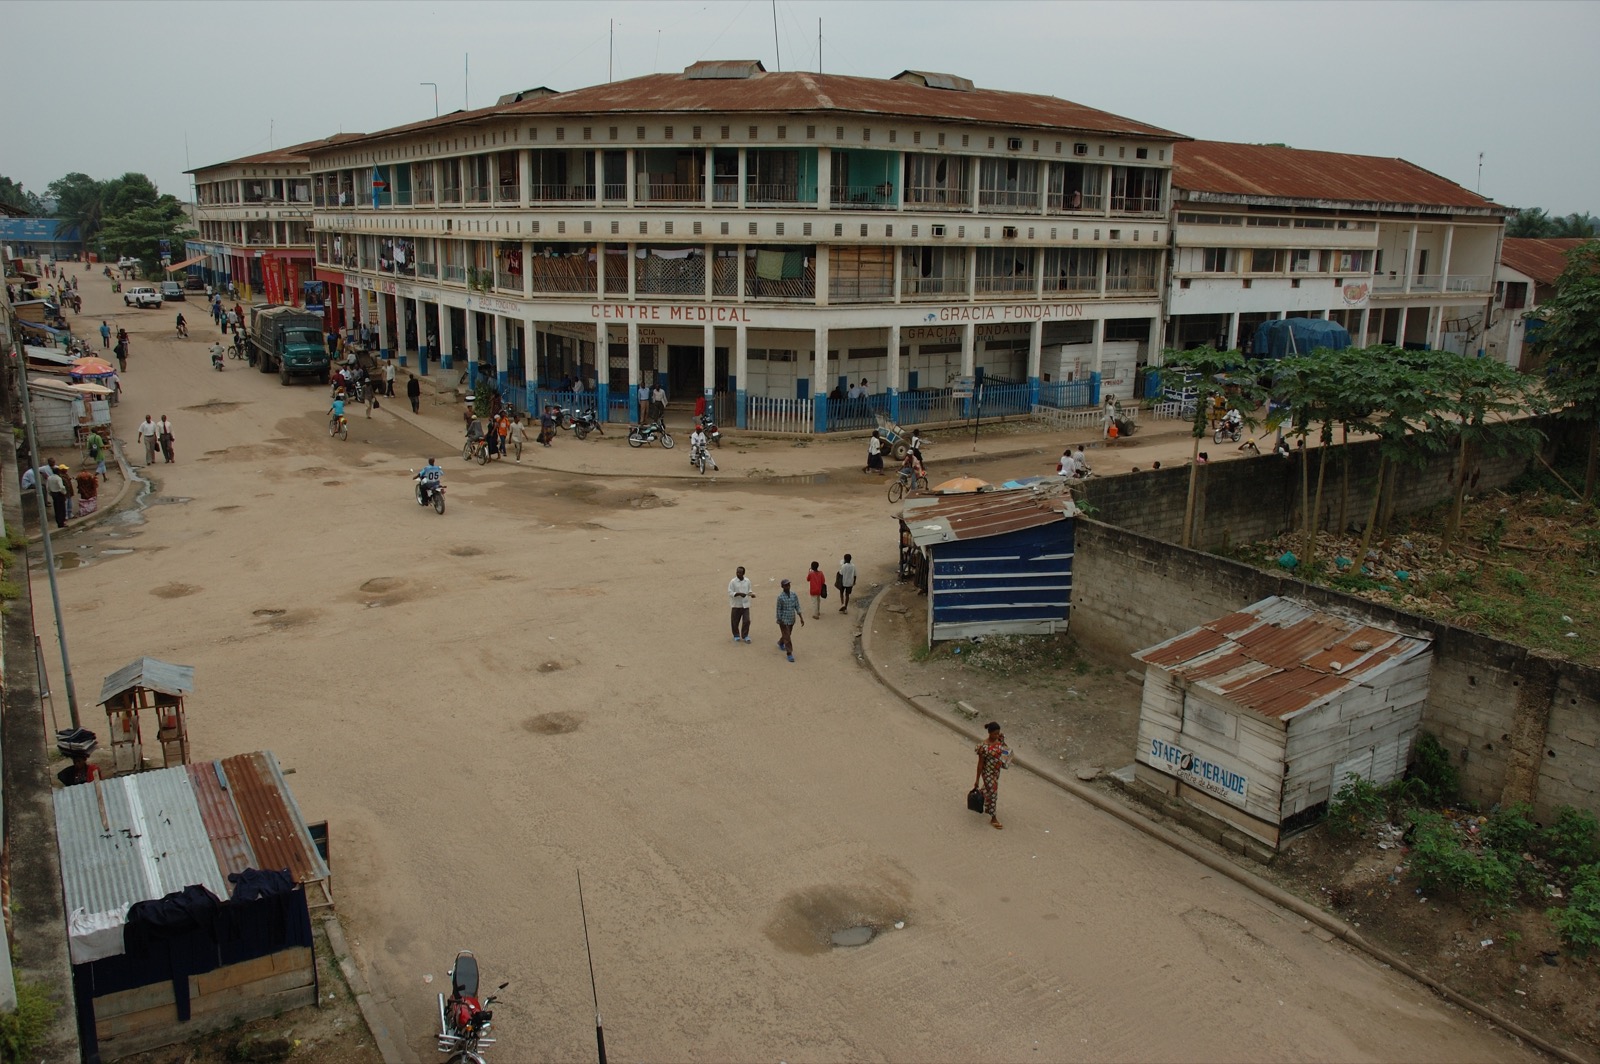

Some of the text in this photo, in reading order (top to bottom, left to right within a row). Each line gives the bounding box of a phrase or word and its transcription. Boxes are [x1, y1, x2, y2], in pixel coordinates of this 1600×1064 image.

[591, 304, 751, 322] CENTRE MEDICAL
[940, 304, 1083, 321] GRACIA FONDATION
[626, 328, 657, 336] ACIA
[908, 323, 1031, 339] GRACIA ONDATIO
[617, 336, 665, 345] FOATION
[940, 335, 962, 344] CENTR
[428, 471, 439, 480] 05
[1151, 738, 1246, 795] STAFF EMERAUDE
